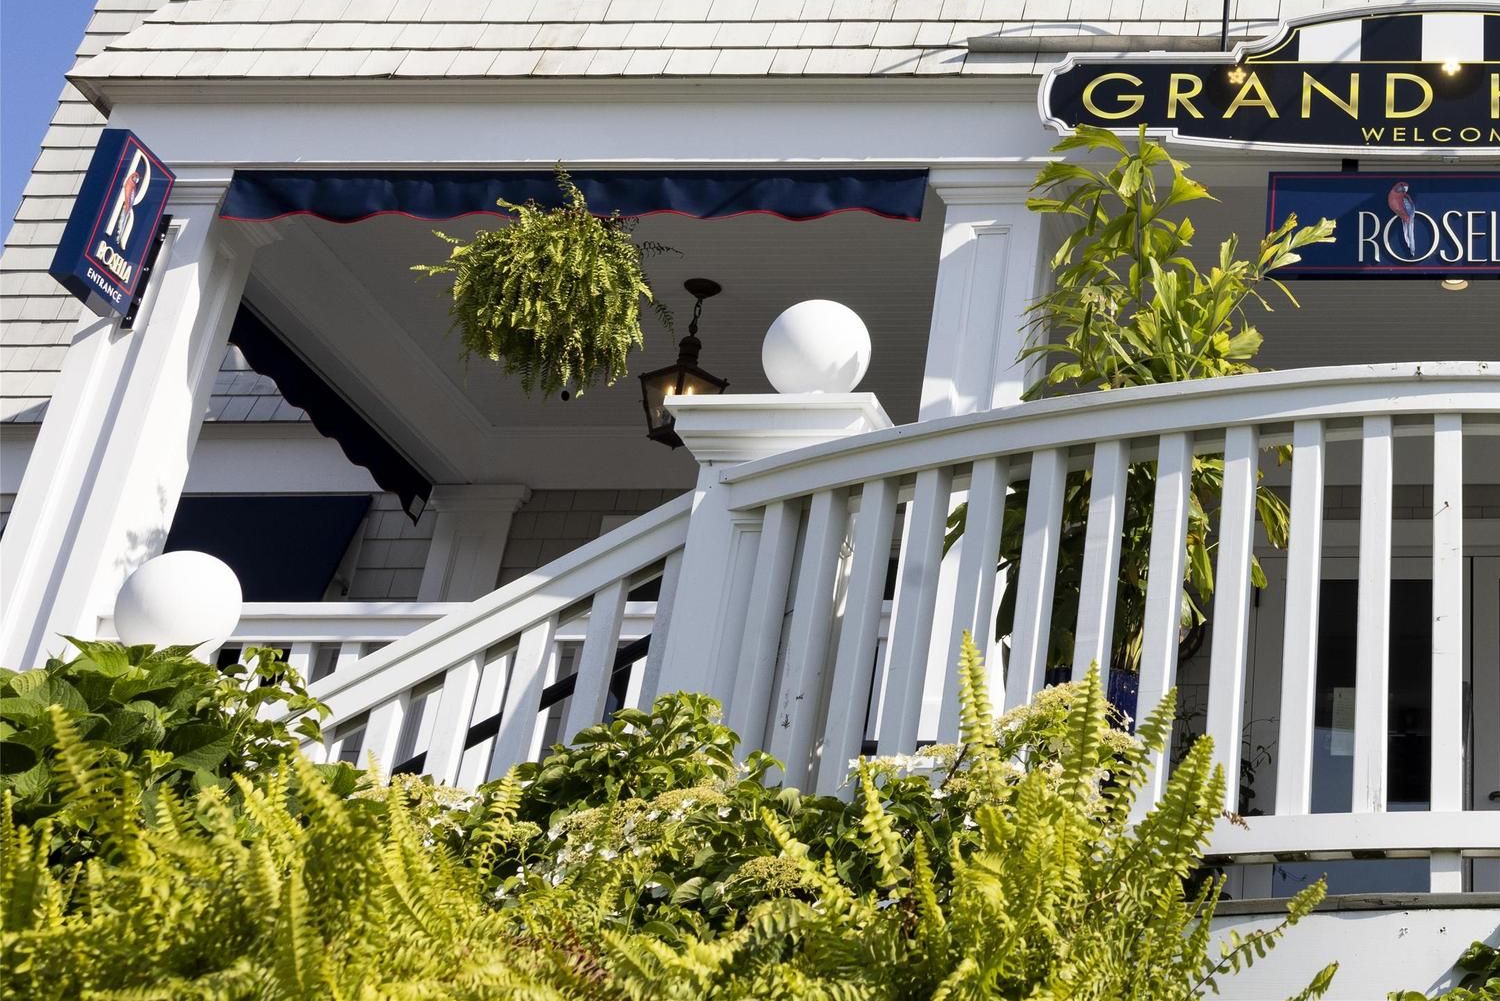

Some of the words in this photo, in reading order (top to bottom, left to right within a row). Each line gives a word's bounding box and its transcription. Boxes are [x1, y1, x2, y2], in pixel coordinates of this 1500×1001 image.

[1081, 71, 1434, 120] GRAND
[105, 148, 151, 250] R
[86, 267, 122, 304] ENTRANCE
